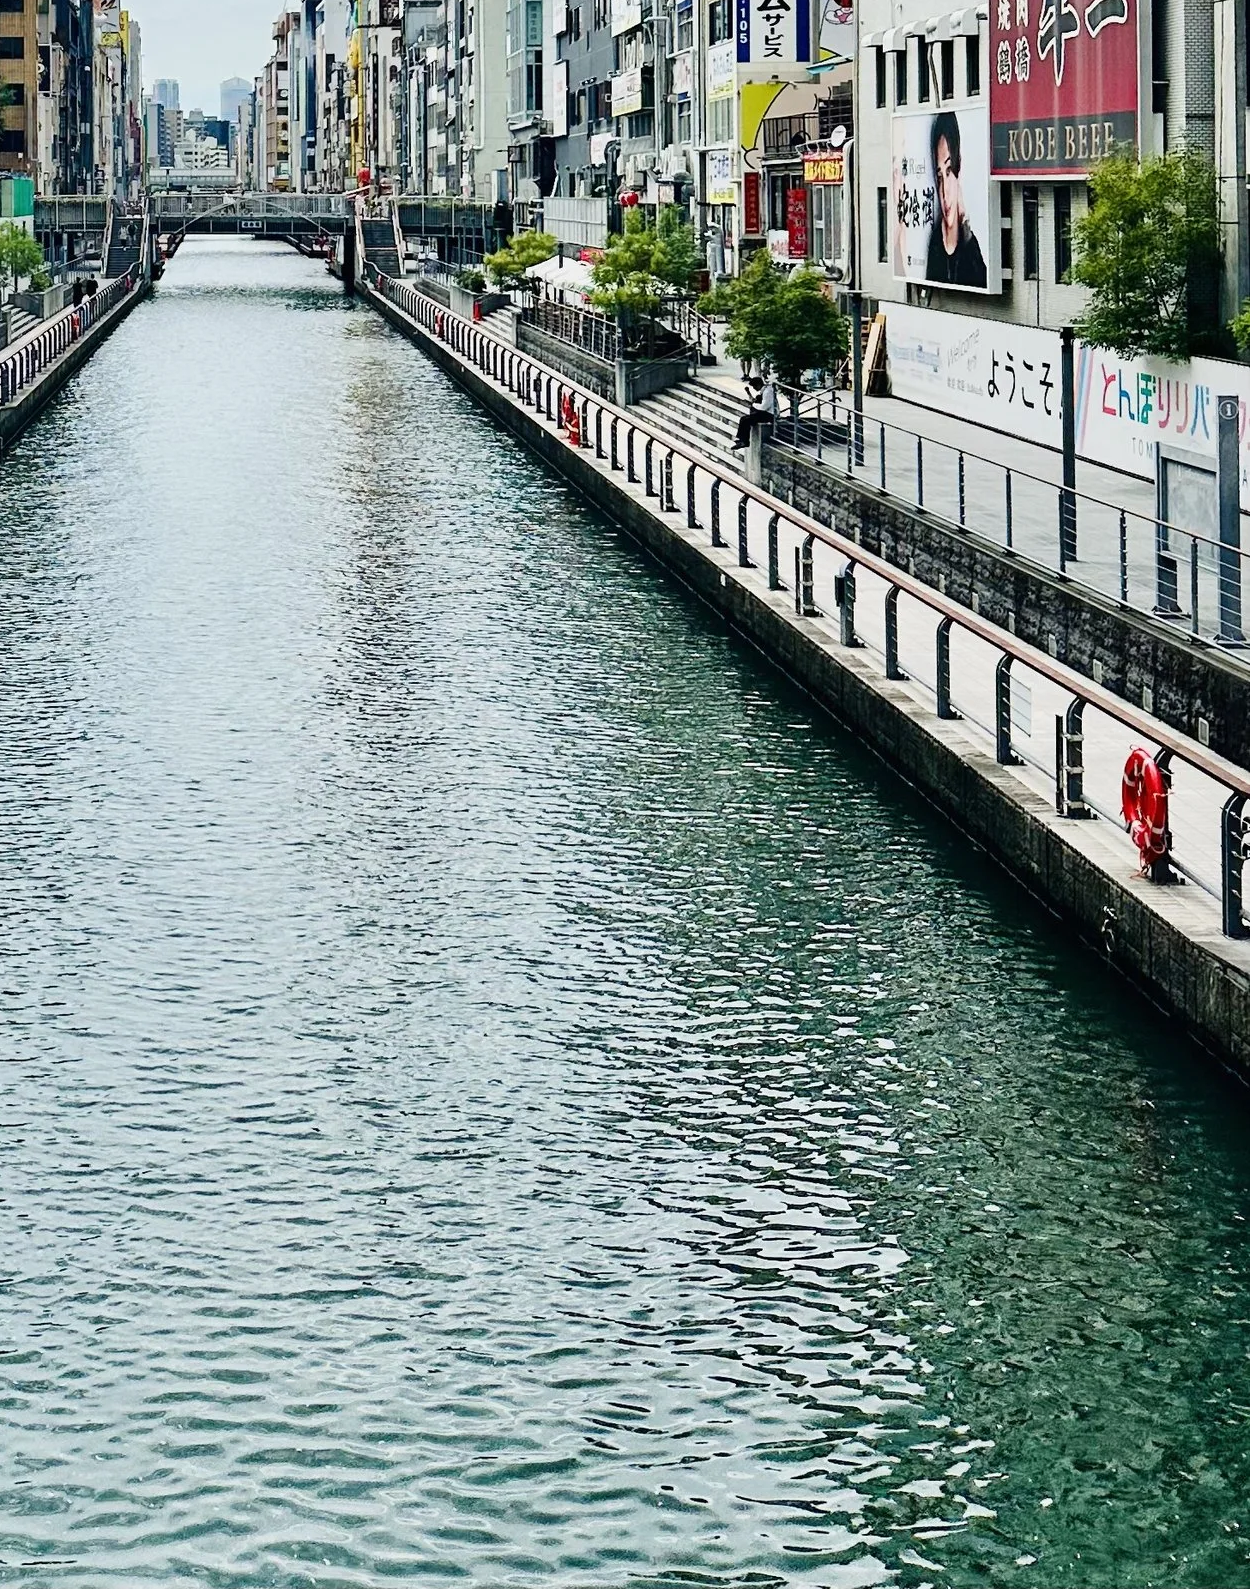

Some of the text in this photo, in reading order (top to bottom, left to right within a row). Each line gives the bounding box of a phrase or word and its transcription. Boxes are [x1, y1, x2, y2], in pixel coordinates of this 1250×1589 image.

[996, 35, 1031, 85] 鶴橋
[1008, 121, 1117, 162] KOBE BEEF
